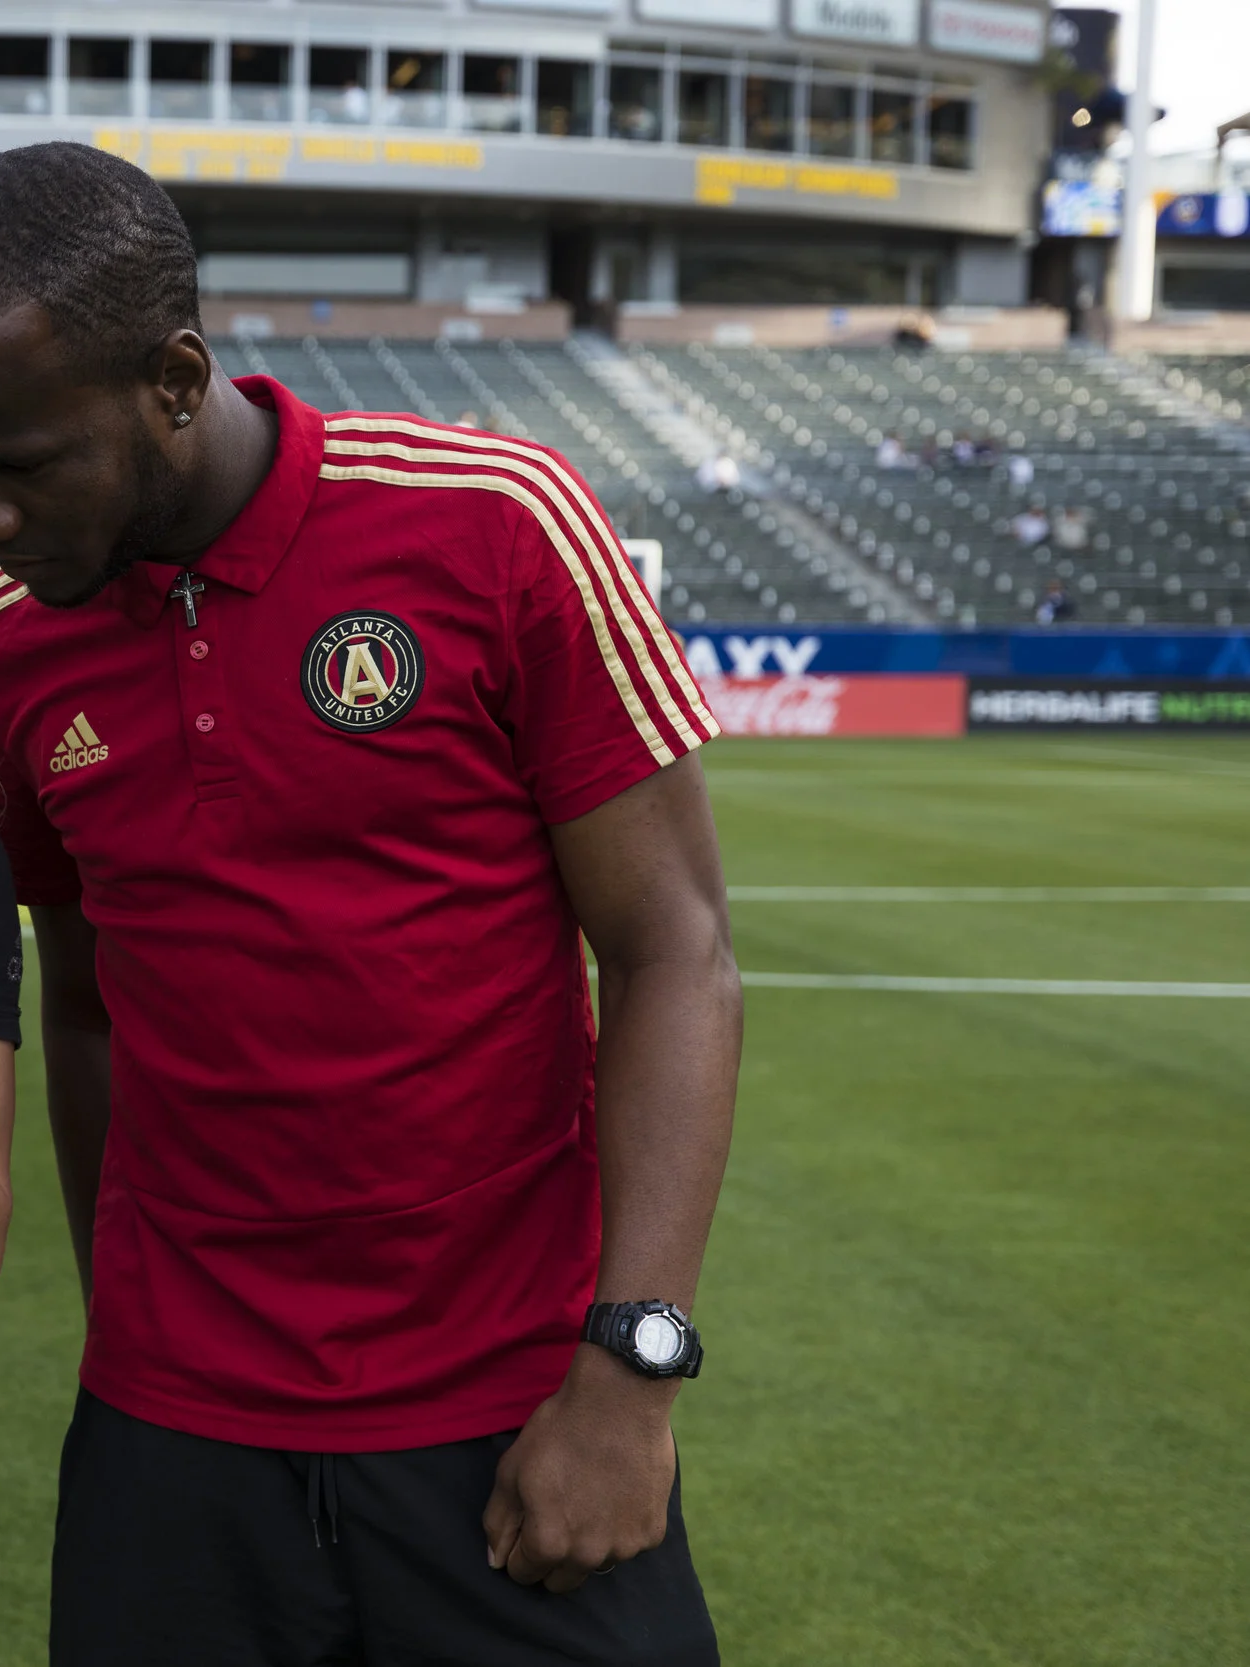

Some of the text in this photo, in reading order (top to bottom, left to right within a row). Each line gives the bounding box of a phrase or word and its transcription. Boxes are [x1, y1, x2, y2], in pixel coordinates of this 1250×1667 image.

[321, 621, 395, 652] ATLANTA
[325, 686, 408, 721] UNITED FC
[50, 745, 109, 773] adidas
